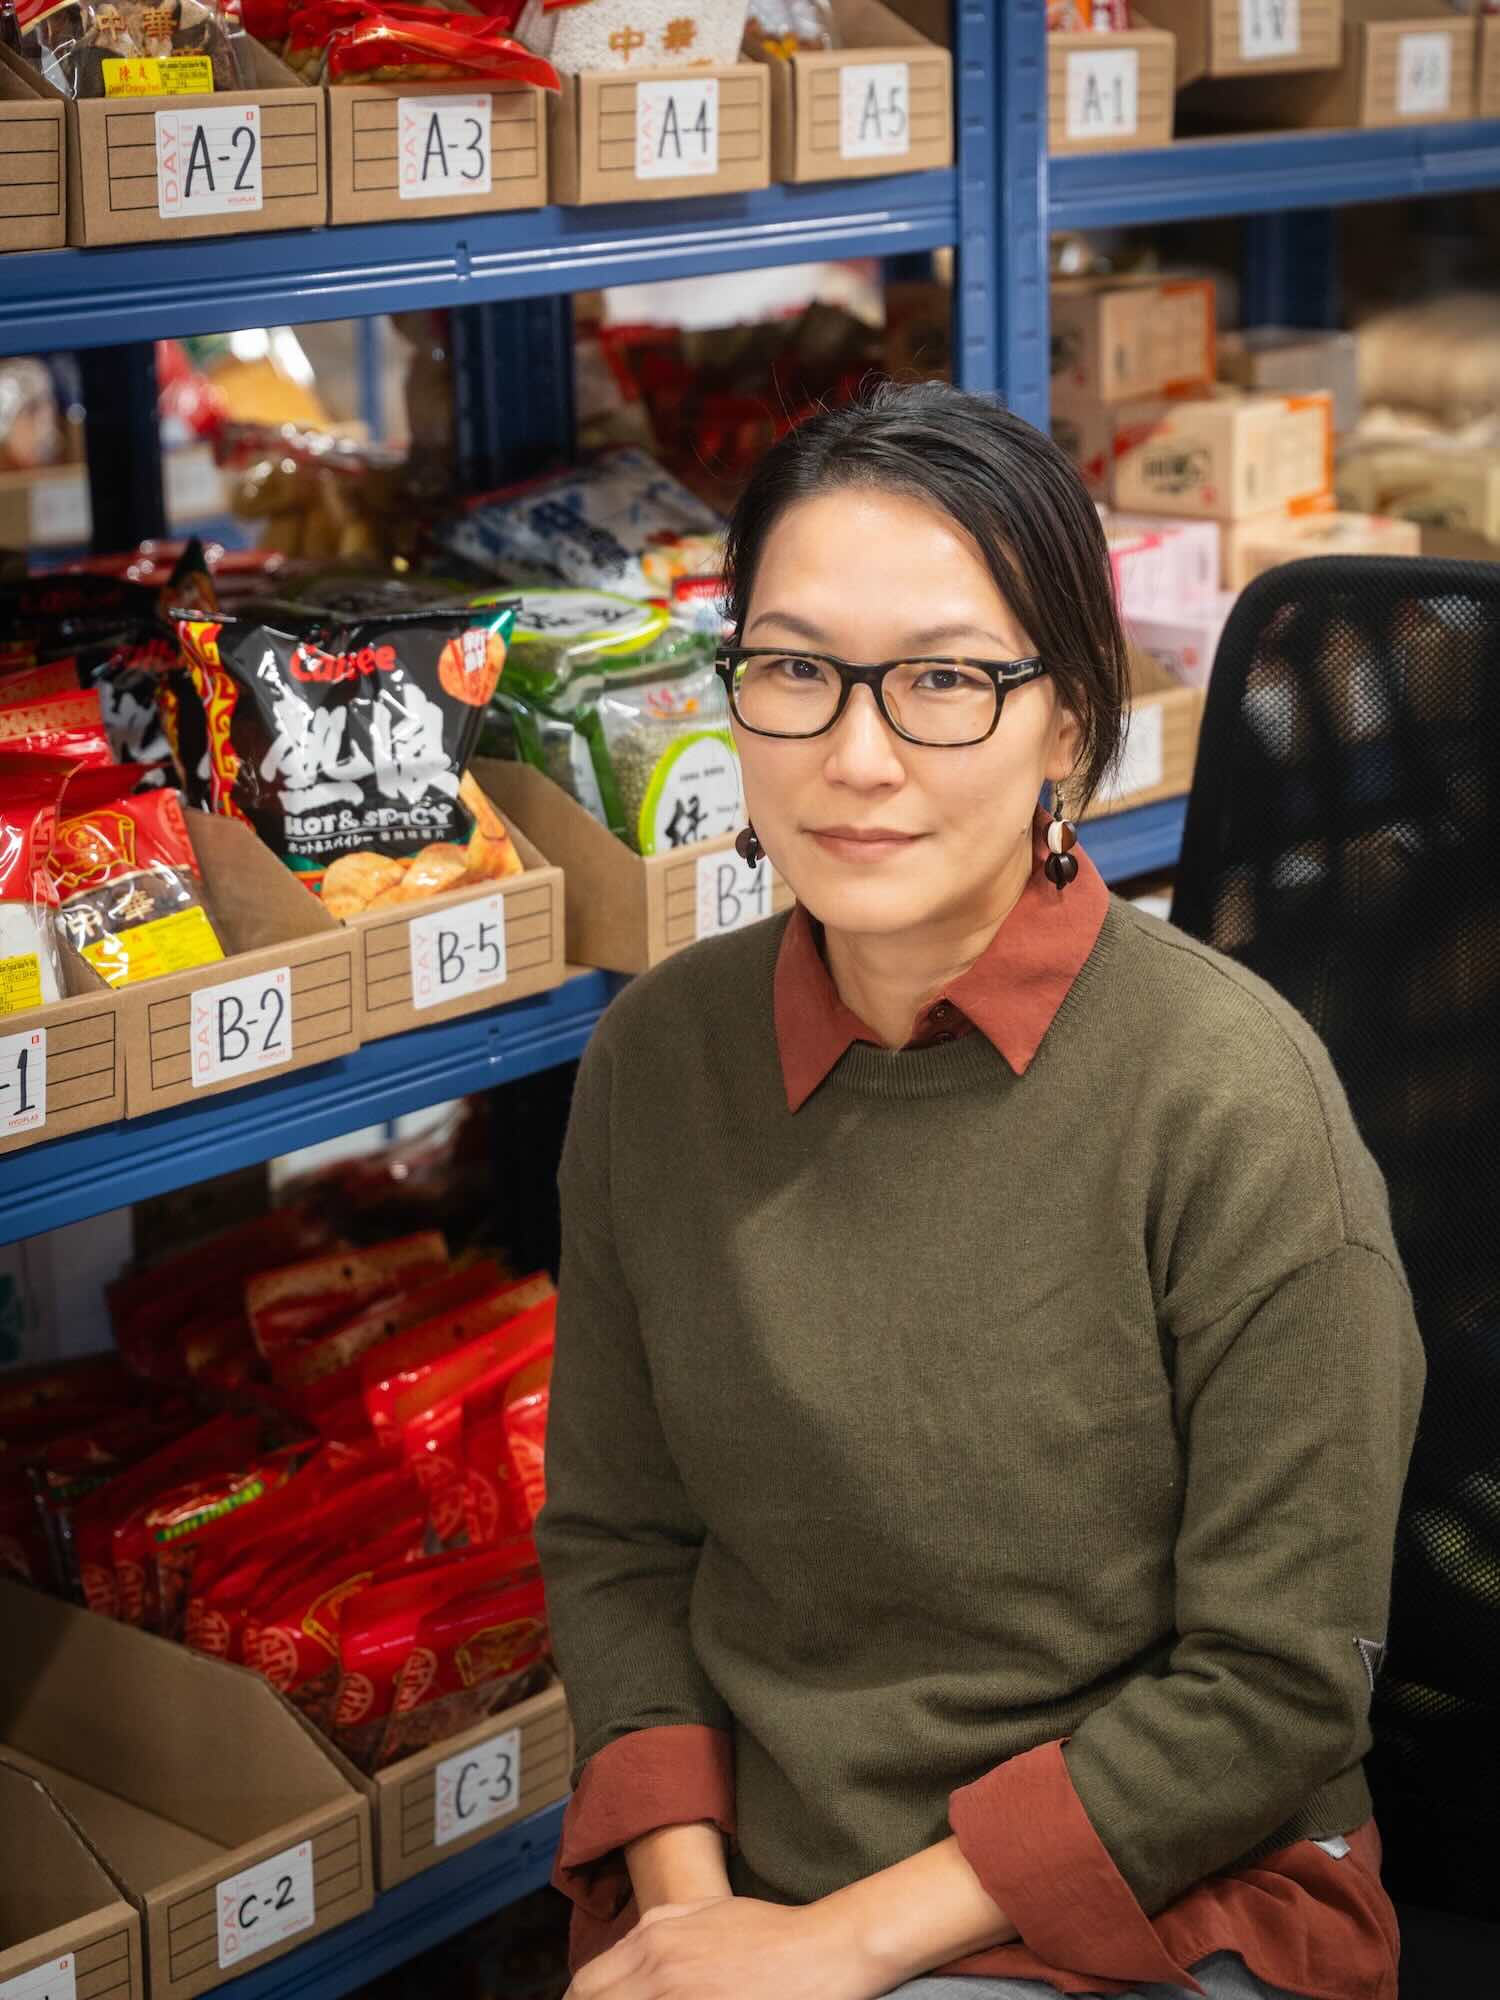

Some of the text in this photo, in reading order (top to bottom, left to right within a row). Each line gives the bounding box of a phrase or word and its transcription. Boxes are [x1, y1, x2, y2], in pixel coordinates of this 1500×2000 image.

[657, 96, 713, 159] A-4
[858, 79, 906, 141] A-5
[161, 128, 178, 204] DAY
[184, 125, 256, 198] A-2
[422, 112, 485, 181] A-3
[717, 862, 766, 927] B-4
[439, 922, 500, 984] B-5
[197, 1007, 209, 1073] DAY
[218, 987, 284, 1063] B-2
[455, 1752, 512, 1820] C-3
[238, 1875, 295, 1929] C-2
